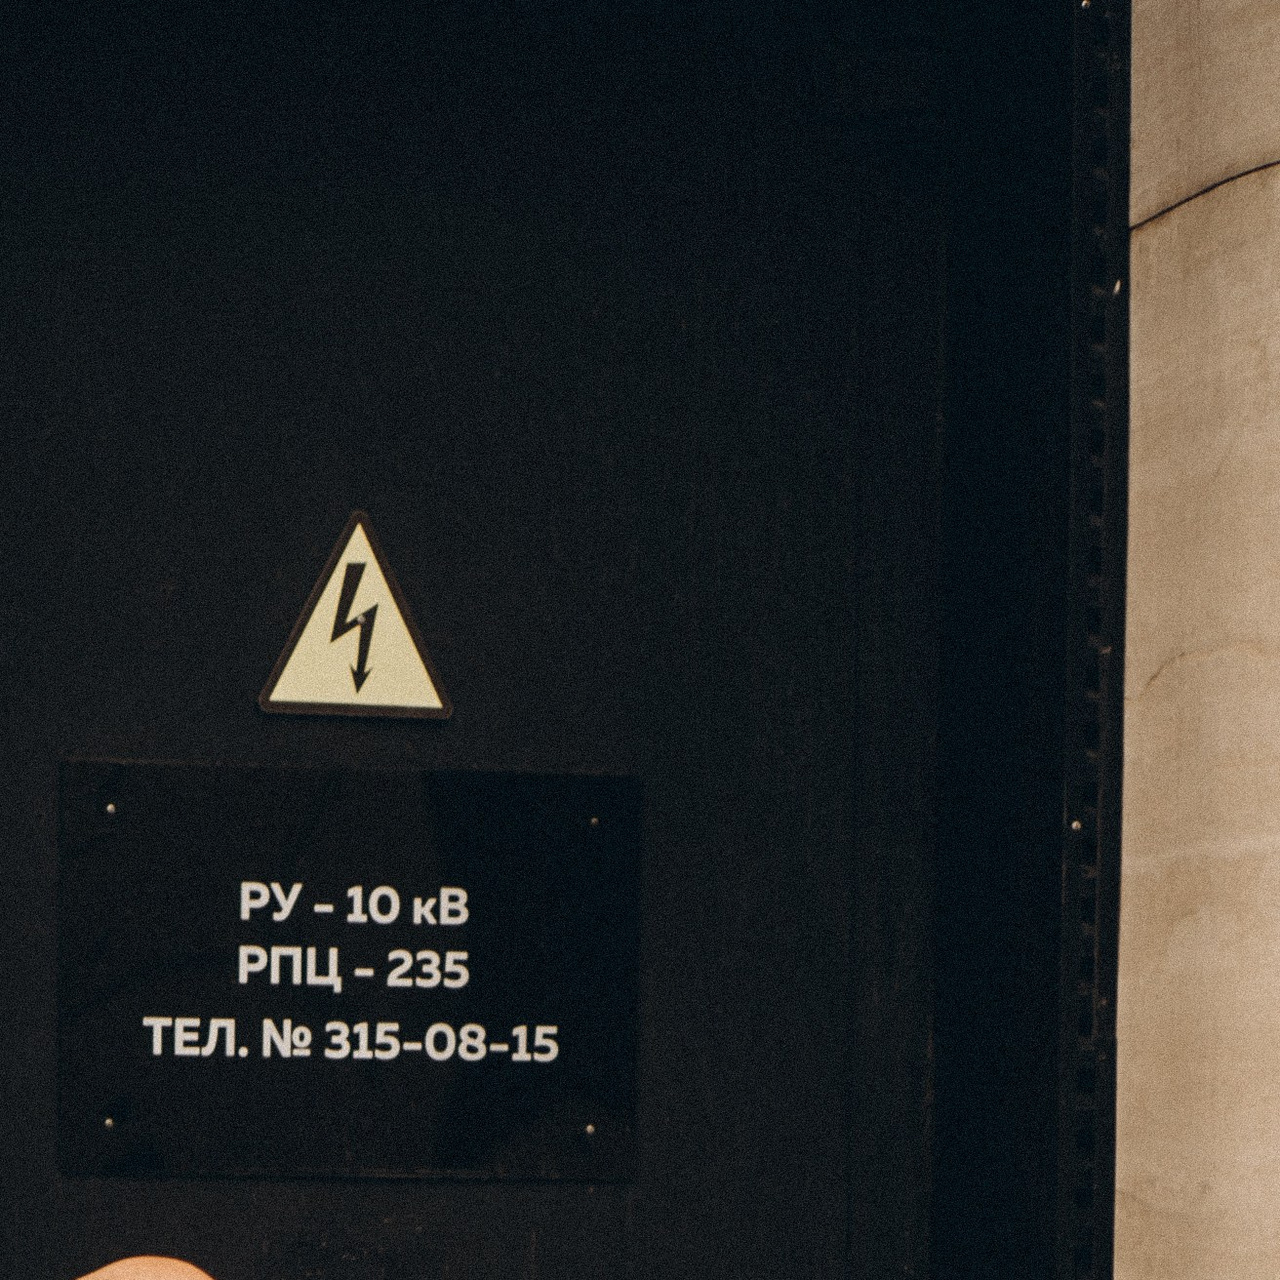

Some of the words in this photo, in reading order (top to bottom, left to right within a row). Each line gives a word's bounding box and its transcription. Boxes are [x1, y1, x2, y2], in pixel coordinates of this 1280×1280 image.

[240, 881, 303, 922] РУ
[346, 885, 401, 925] 10
[412, 887, 469, 926] кВ
[238, 944, 342, 994] РПЦ
[386, 949, 470, 989] 235
[142, 1016, 249, 1058] ТЕЛ.
[262, 1018, 313, 1059] №
[324, 1020, 559, 1063] 315-08-15
